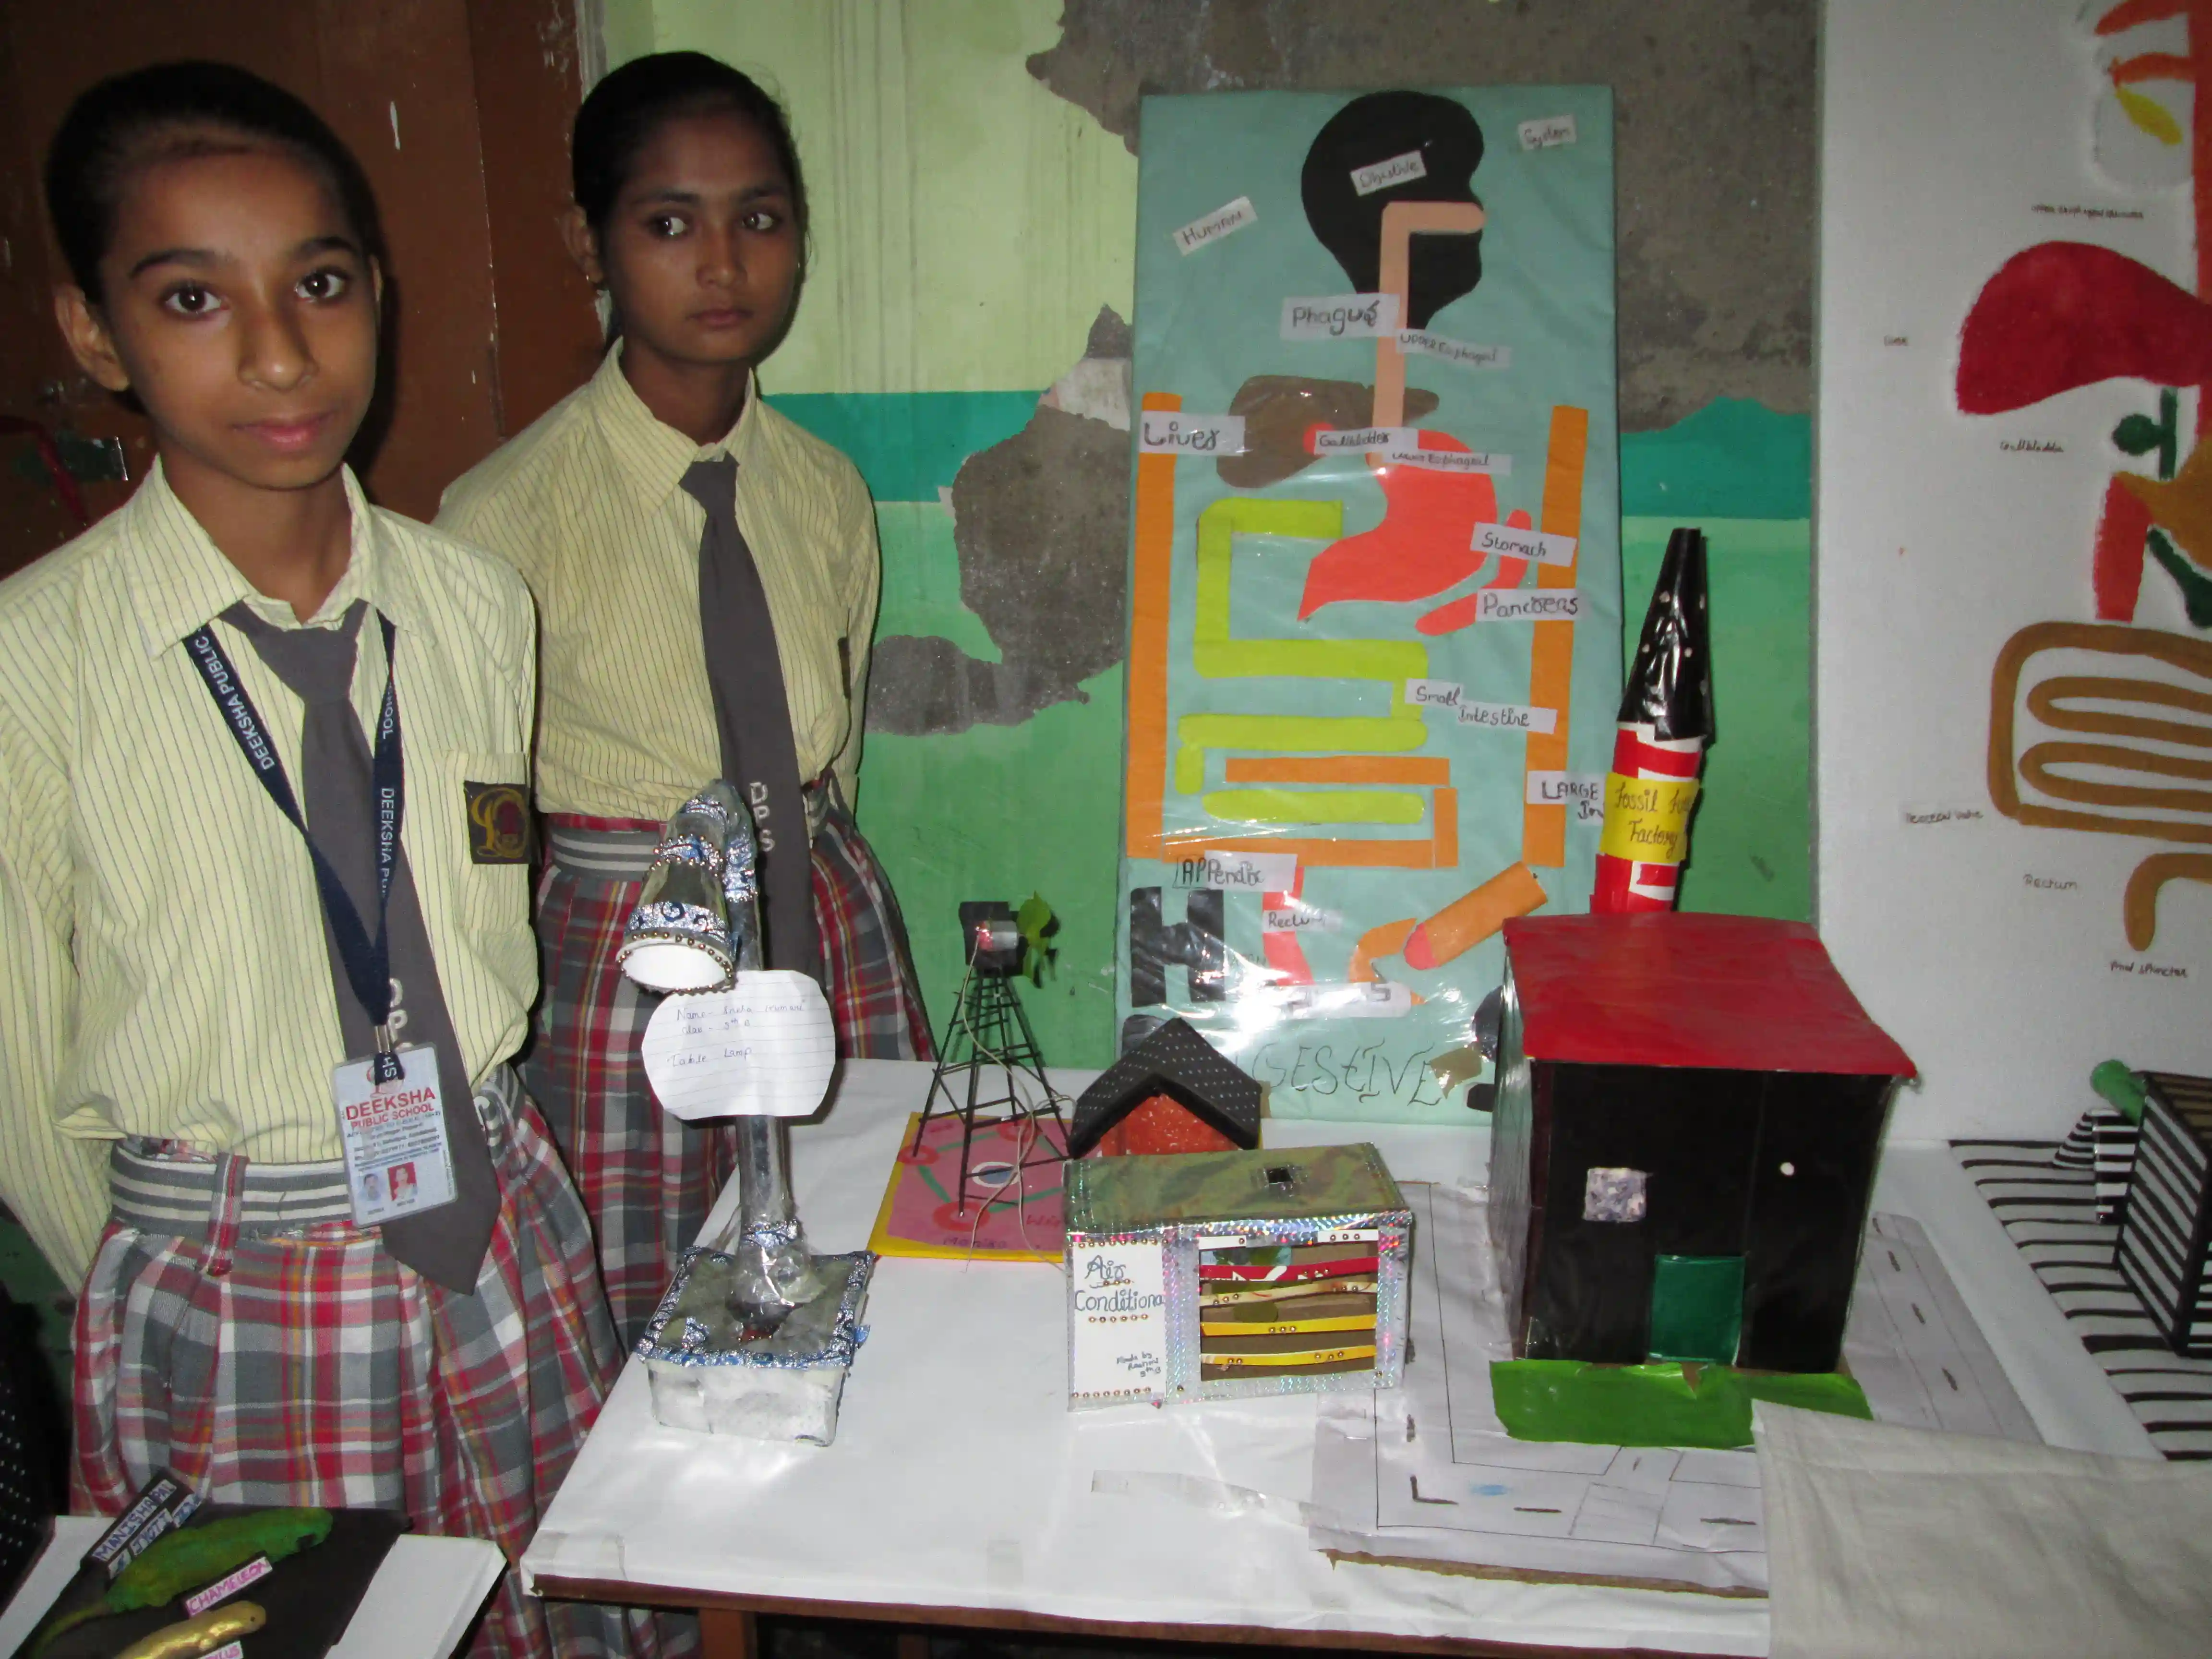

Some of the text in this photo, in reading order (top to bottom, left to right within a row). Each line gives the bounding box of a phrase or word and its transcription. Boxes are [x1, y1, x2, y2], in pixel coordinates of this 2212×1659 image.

[1481, 531, 1547, 557] Stomach
[194, 636, 276, 770] DEEKSHA PUBLIC
[1416, 685, 1461, 707] Small
[1541, 780, 1600, 801] LARGE
[381, 788, 395, 864] DEEKSHA
[749, 781, 776, 852] DPS
[1627, 817, 1678, 859] Factory
[346, 1087, 436, 1120] DEEKSHA
[351, 1104, 435, 1130] PUBLIC SCHOOL
